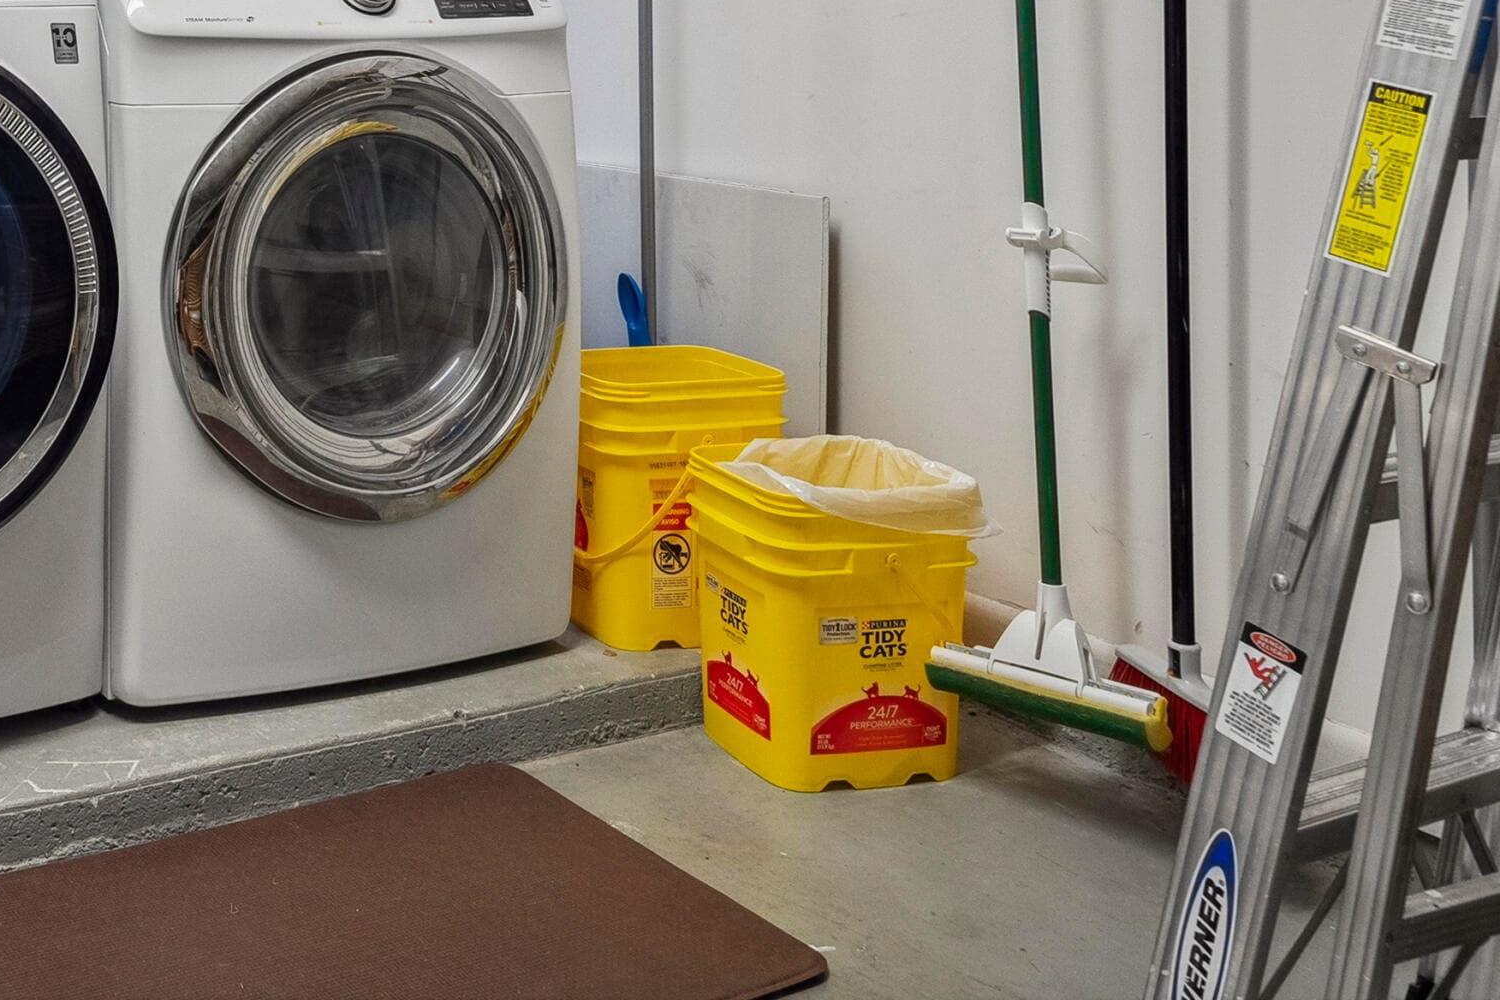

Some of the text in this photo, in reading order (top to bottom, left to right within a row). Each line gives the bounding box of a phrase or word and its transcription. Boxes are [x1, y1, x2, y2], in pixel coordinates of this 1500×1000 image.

[1375, 87, 1426, 108] CAUTION
[720, 594, 746, 620] TIDY
[720, 608, 749, 635] CATS
[870, 619, 905, 629] PURINA
[861, 629, 905, 644] TIDY
[860, 643, 907, 659] CATS
[867, 704, 899, 720] 24/7
[850, 718, 913, 730] PERFORMANCE
